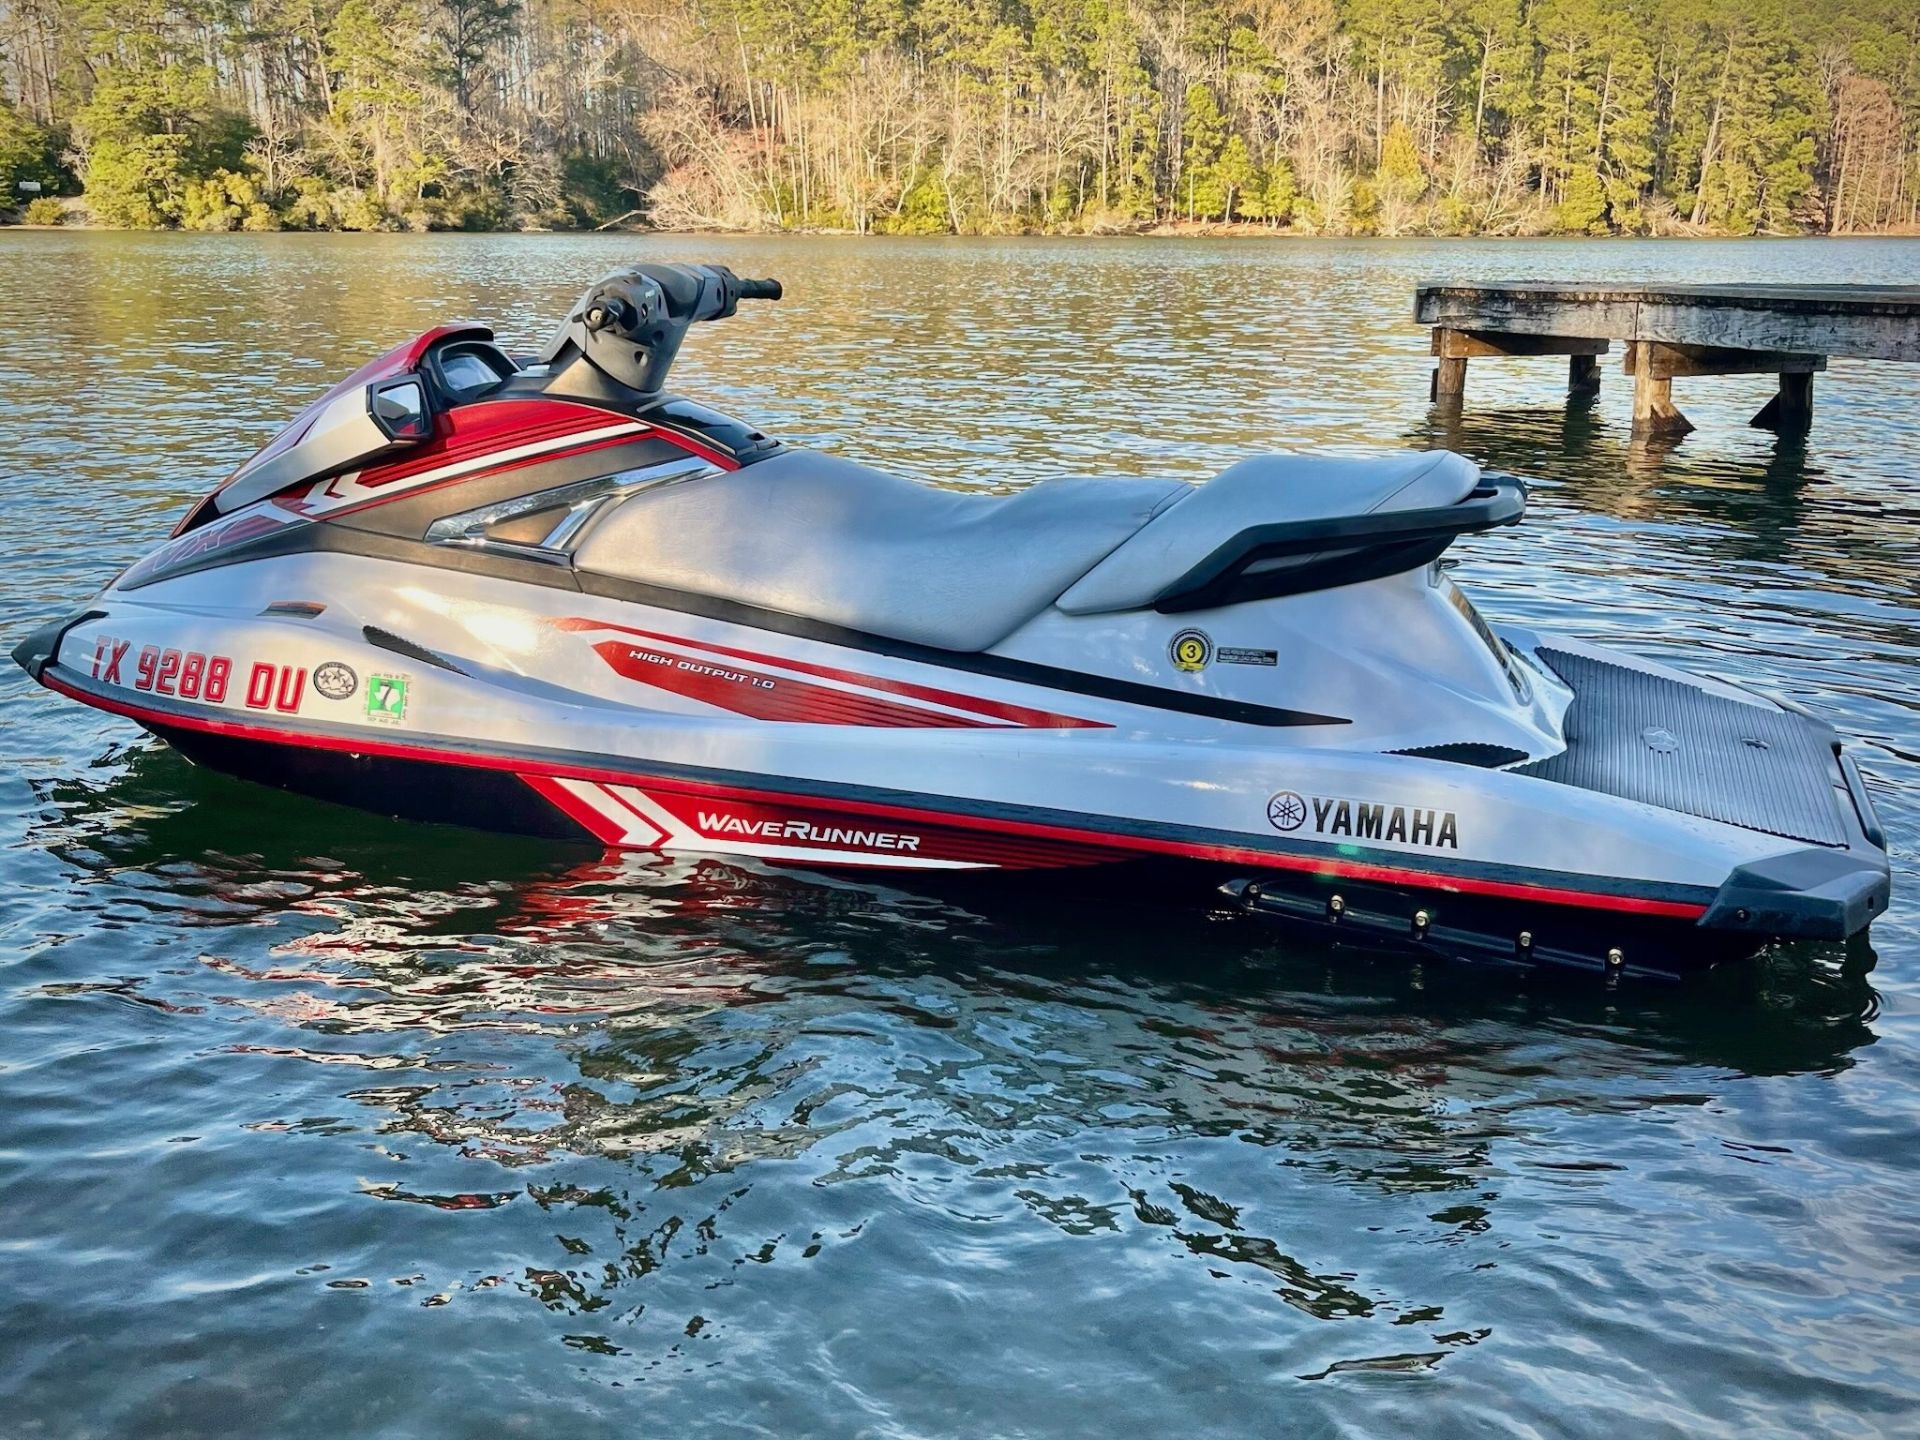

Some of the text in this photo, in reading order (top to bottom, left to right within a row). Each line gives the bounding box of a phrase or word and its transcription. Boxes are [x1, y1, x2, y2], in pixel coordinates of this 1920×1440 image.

[629, 650, 776, 690] HIGH OUTPUT 1.0
[1186, 644, 1197, 659] 3
[92, 635, 130, 684] TX
[135, 644, 233, 703] 9288
[245, 662, 308, 714] DU
[380, 682, 394, 709] 7
[1312, 797, 1458, 849] YAMAHA
